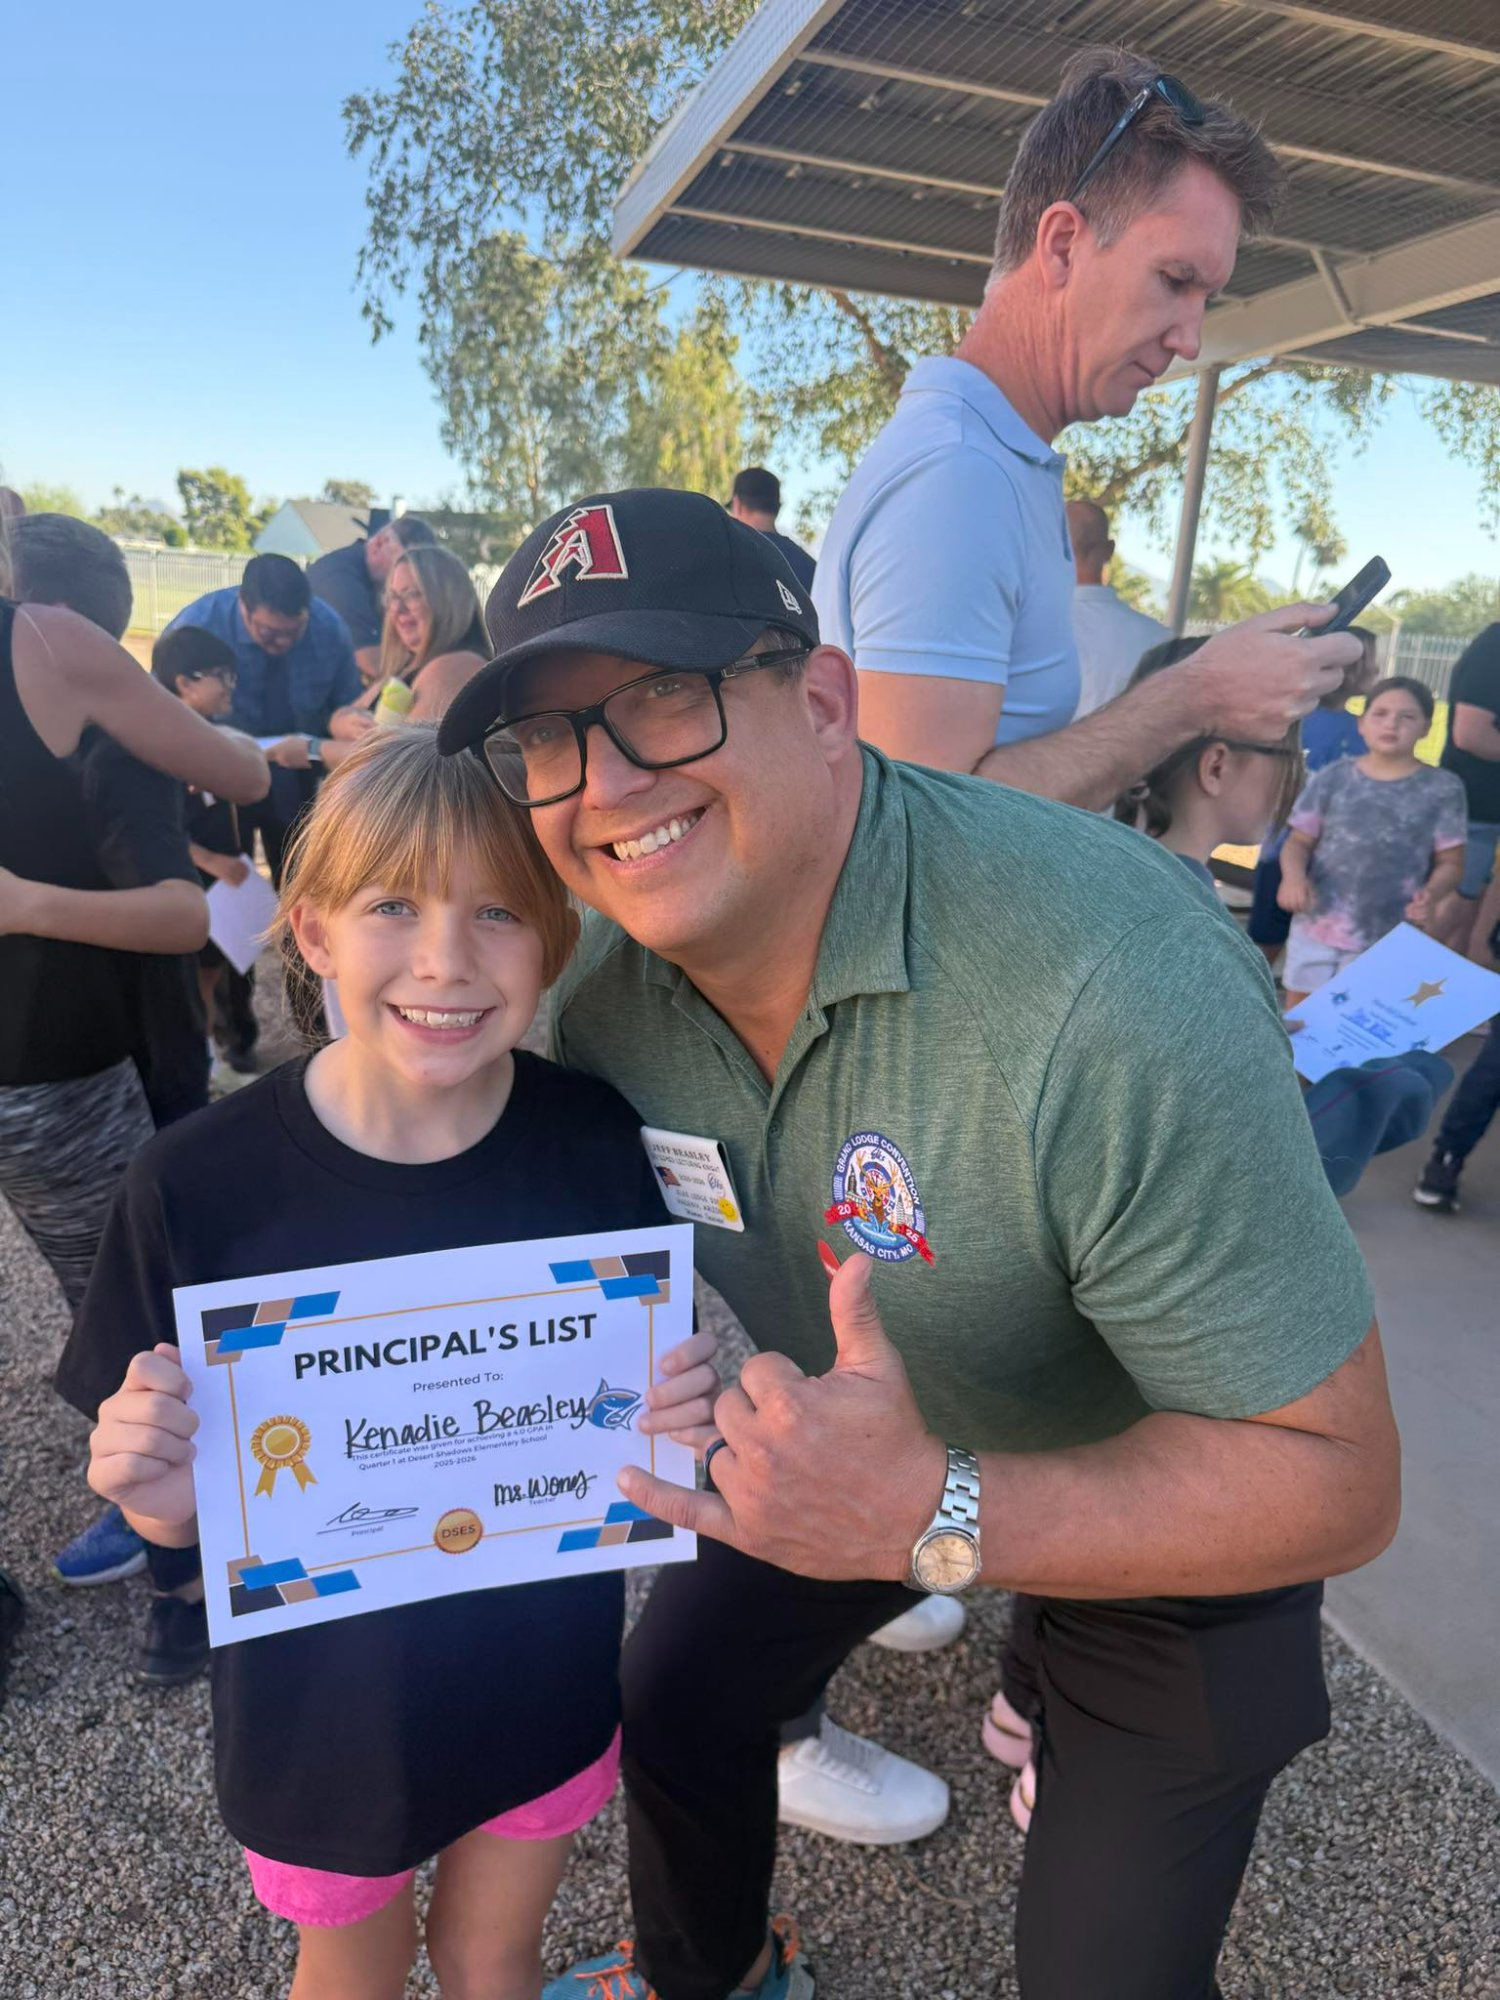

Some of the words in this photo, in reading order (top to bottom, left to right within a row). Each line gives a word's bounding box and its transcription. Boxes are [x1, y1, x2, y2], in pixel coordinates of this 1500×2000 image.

[836, 1143, 853, 1173] GRAND
[851, 1134, 880, 1147] LODGE
[880, 1139, 921, 1206] CONVENTION
[837, 1203, 852, 1215] 20
[843, 1220, 876, 1255] KANSAS
[899, 1243, 914, 1257] MO
[294, 1323, 519, 1380] PRINCIPAL'S
[529, 1313, 597, 1347] LIST
[413, 1373, 481, 1393] Presented
[483, 1371, 504, 1383] To:
[344, 1413, 460, 1459] Kenadie
[473, 1394, 587, 1430] Beasley
[351, 1453, 369, 1462] This
[370, 1445, 412, 1459] certificate
[413, 1444, 429, 1453] was
[430, 1439, 453, 1450] given
[454, 1438, 466, 1446] for
[467, 1431, 505, 1445] achieving
[527, 1425, 544, 1434] GPA
[545, 1424, 554, 1432] in
[358, 1459, 391, 1470] Quarter
[408, 1451, 434, 1462] Desert
[435, 1446, 473, 1458] Shadows
[473, 1439, 519, 1452] Elementary
[520, 1434, 548, 1445] School
[433, 1455, 478, 1468] 2025-2026
[528, 1469, 598, 1500] Wong
[351, 1525, 384, 1537] Principal
[441, 1524, 476, 1539] DSES
